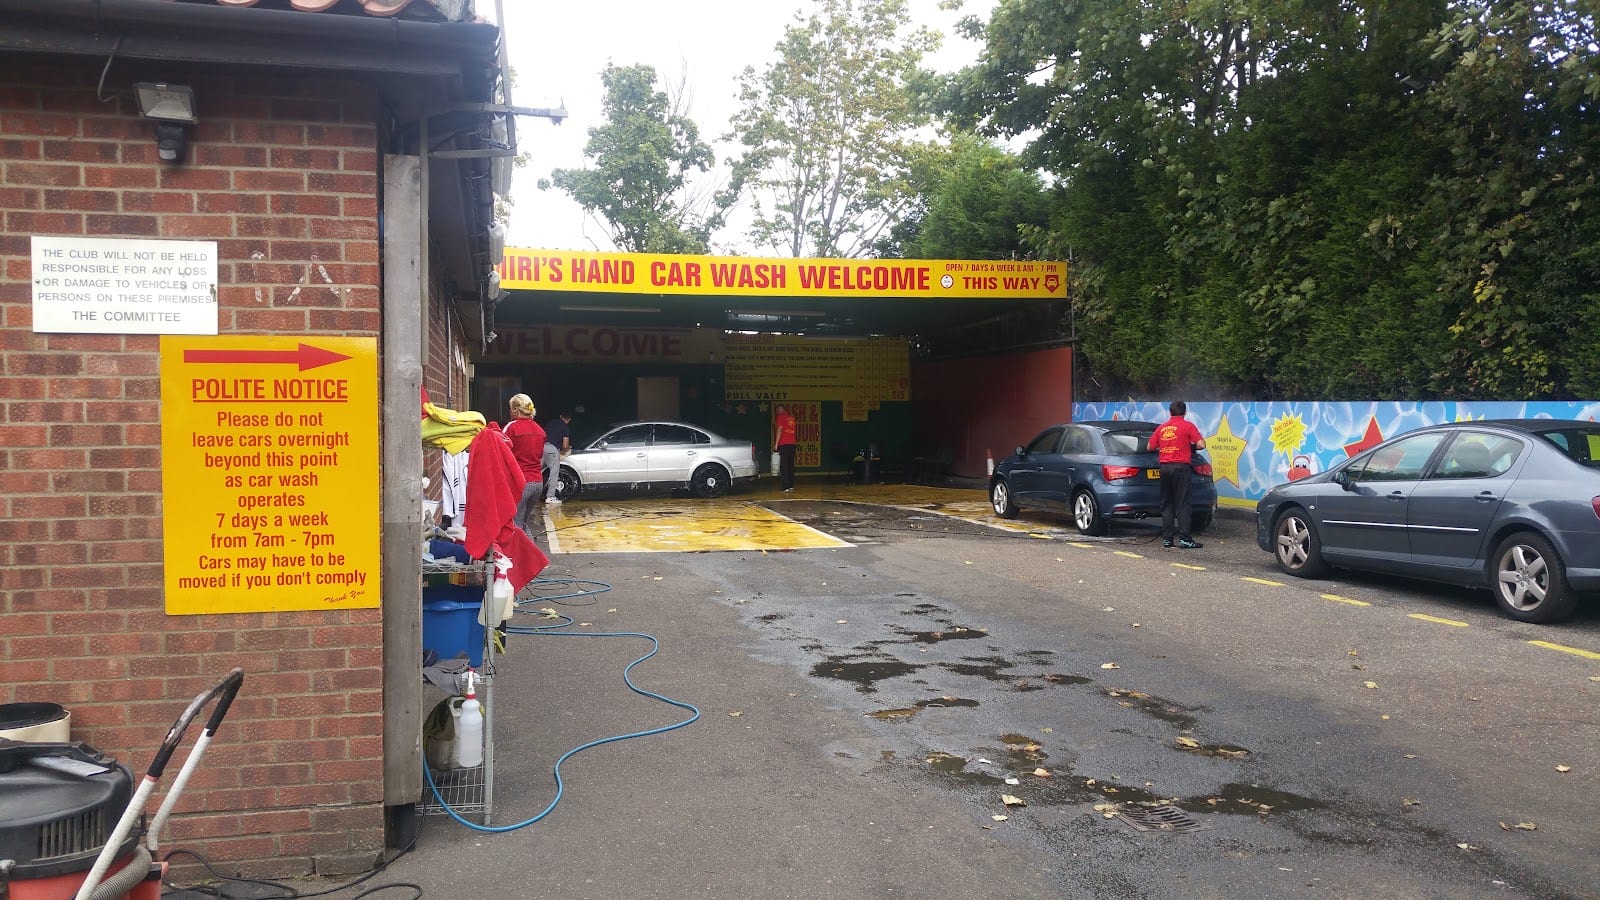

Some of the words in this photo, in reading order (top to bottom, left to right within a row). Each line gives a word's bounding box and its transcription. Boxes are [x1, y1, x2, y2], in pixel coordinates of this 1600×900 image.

[42, 249, 64, 258] THE
[69, 249, 98, 259] CLUB
[104, 251, 129, 260] WILL
[134, 252, 156, 261] NOT
[160, 252, 174, 261] BE
[180, 252, 208, 262] HELD
[42, 263, 119, 274] RESPONSIBLE
[124, 265, 147, 274] FOR
[152, 266, 173, 276] ANY
[178, 267, 207, 276] LOSS
[571, 258, 635, 285] HAND
[651, 261, 701, 287] CAR
[711, 263, 786, 288] WASH
[799, 265, 930, 291] WELCOME
[945, 263, 963, 272] OPEN
[965, 264, 969, 272] 7
[971, 264, 989, 272] DAYS
[990, 264, 995, 272] A
[996, 264, 1015, 272] WEEK
[1023, 264, 1034, 272] AM
[1041, 264, 1045, 272] 7
[1046, 265, 1057, 273] PM
[42, 278, 59, 287] OR
[64, 279, 110, 288] DAMAGE
[115, 279, 130, 288] TO
[135, 280, 188, 290] VEHICLES
[192, 281, 207, 290] OR
[962, 276, 998, 290] THIS
[1003, 277, 1040, 290] WAY
[38, 292, 91, 302] PERSONS
[96, 293, 113, 302] ON
[118, 294, 153, 303] THESE
[158, 294, 213, 304] PREMISES
[71, 310, 97, 321] THE
[103, 311, 181, 322] COMMITTEE
[486, 327, 682, 356] WELCOME
[192, 378, 265, 400] POLITE
[274, 378, 348, 400] NOTICE
[727, 392, 750, 400] FULL
[756, 392, 788, 400] VALET
[217, 411, 269, 427] Please
[275, 411, 293, 427] do
[299, 411, 323, 427] not
[193, 432, 234, 448] leave
[239, 435, 272, 448] cars
[278, 431, 349, 450] overnight
[205, 452, 261, 470] beyond
[266, 452, 294, 468] this
[300, 452, 338, 470] point
[225, 476, 243, 488] as
[249, 476, 272, 487] car
[279, 472, 319, 487] wash
[238, 493, 305, 511] operates
[216, 513, 225, 528] 7
[232, 512, 268, 530] days
[274, 515, 283, 527] a
[289, 512, 329, 526] week
[211, 532, 247, 548] from
[253, 532, 285, 548] 7am
[303, 531, 335, 549] 7pm
[199, 554, 232, 570] Cars
[236, 557, 266, 572] may
[272, 553, 306, 568] have
[310, 553, 324, 567] to
[328, 552, 345, 566] be
[179, 573, 226, 588] moved
[231, 572, 241, 587] if
[246, 575, 271, 590] you
[277, 571, 311, 586] don't
[316, 570, 367, 587] comply
[323, 593, 348, 603] Thank
[349, 590, 366, 600] You
